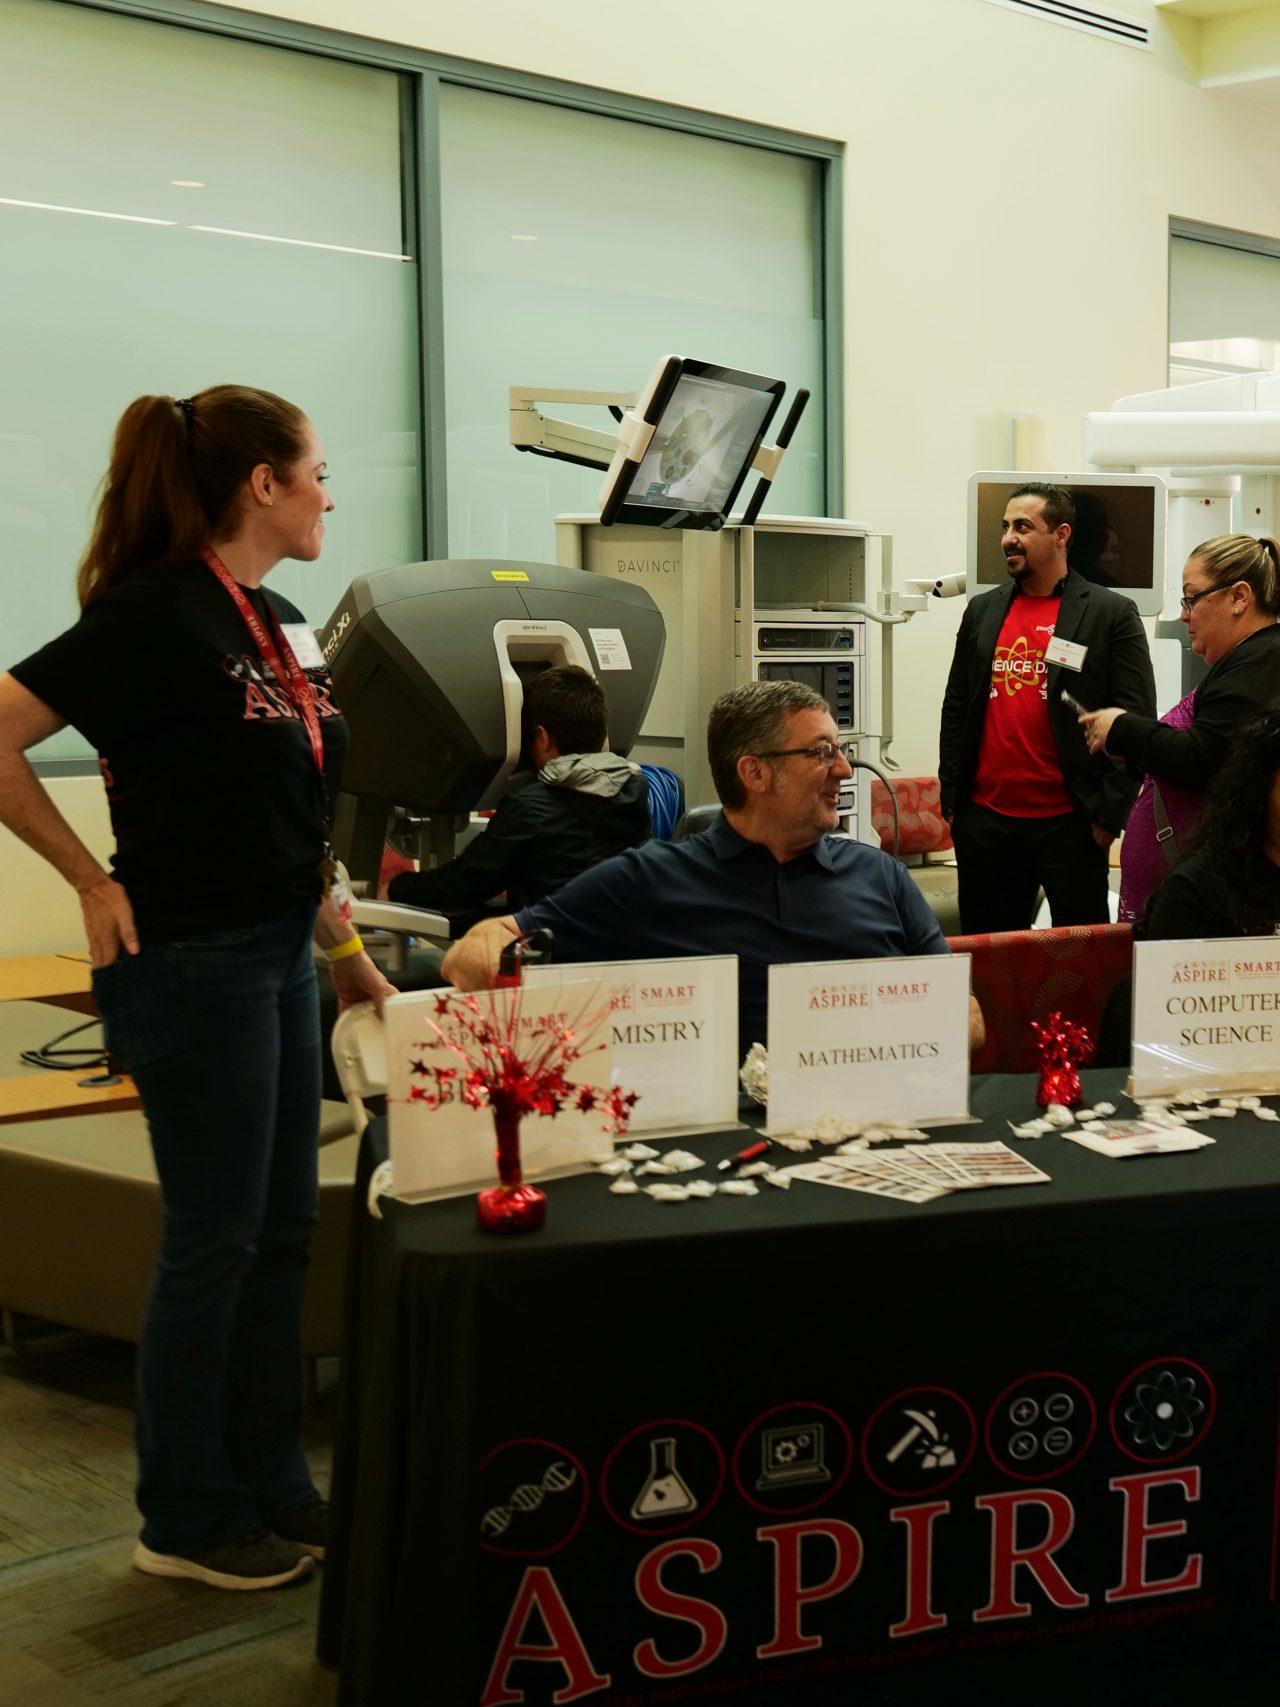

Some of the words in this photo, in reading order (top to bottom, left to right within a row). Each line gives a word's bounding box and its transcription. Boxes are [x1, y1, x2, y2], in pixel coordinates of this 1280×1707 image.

[1172, 968, 1228, 983] ASPIRE
[641, 984, 697, 1000] SMART
[808, 991, 870, 1010] ASPIRE
[877, 982, 930, 997] SMART
[611, 1019, 707, 1046] MISTRY
[1180, 1024, 1273, 1047] SCIENCE
[797, 1041, 940, 1069] MATHEMATICS
[480, 1465, 1202, 1707] ASPIRE
